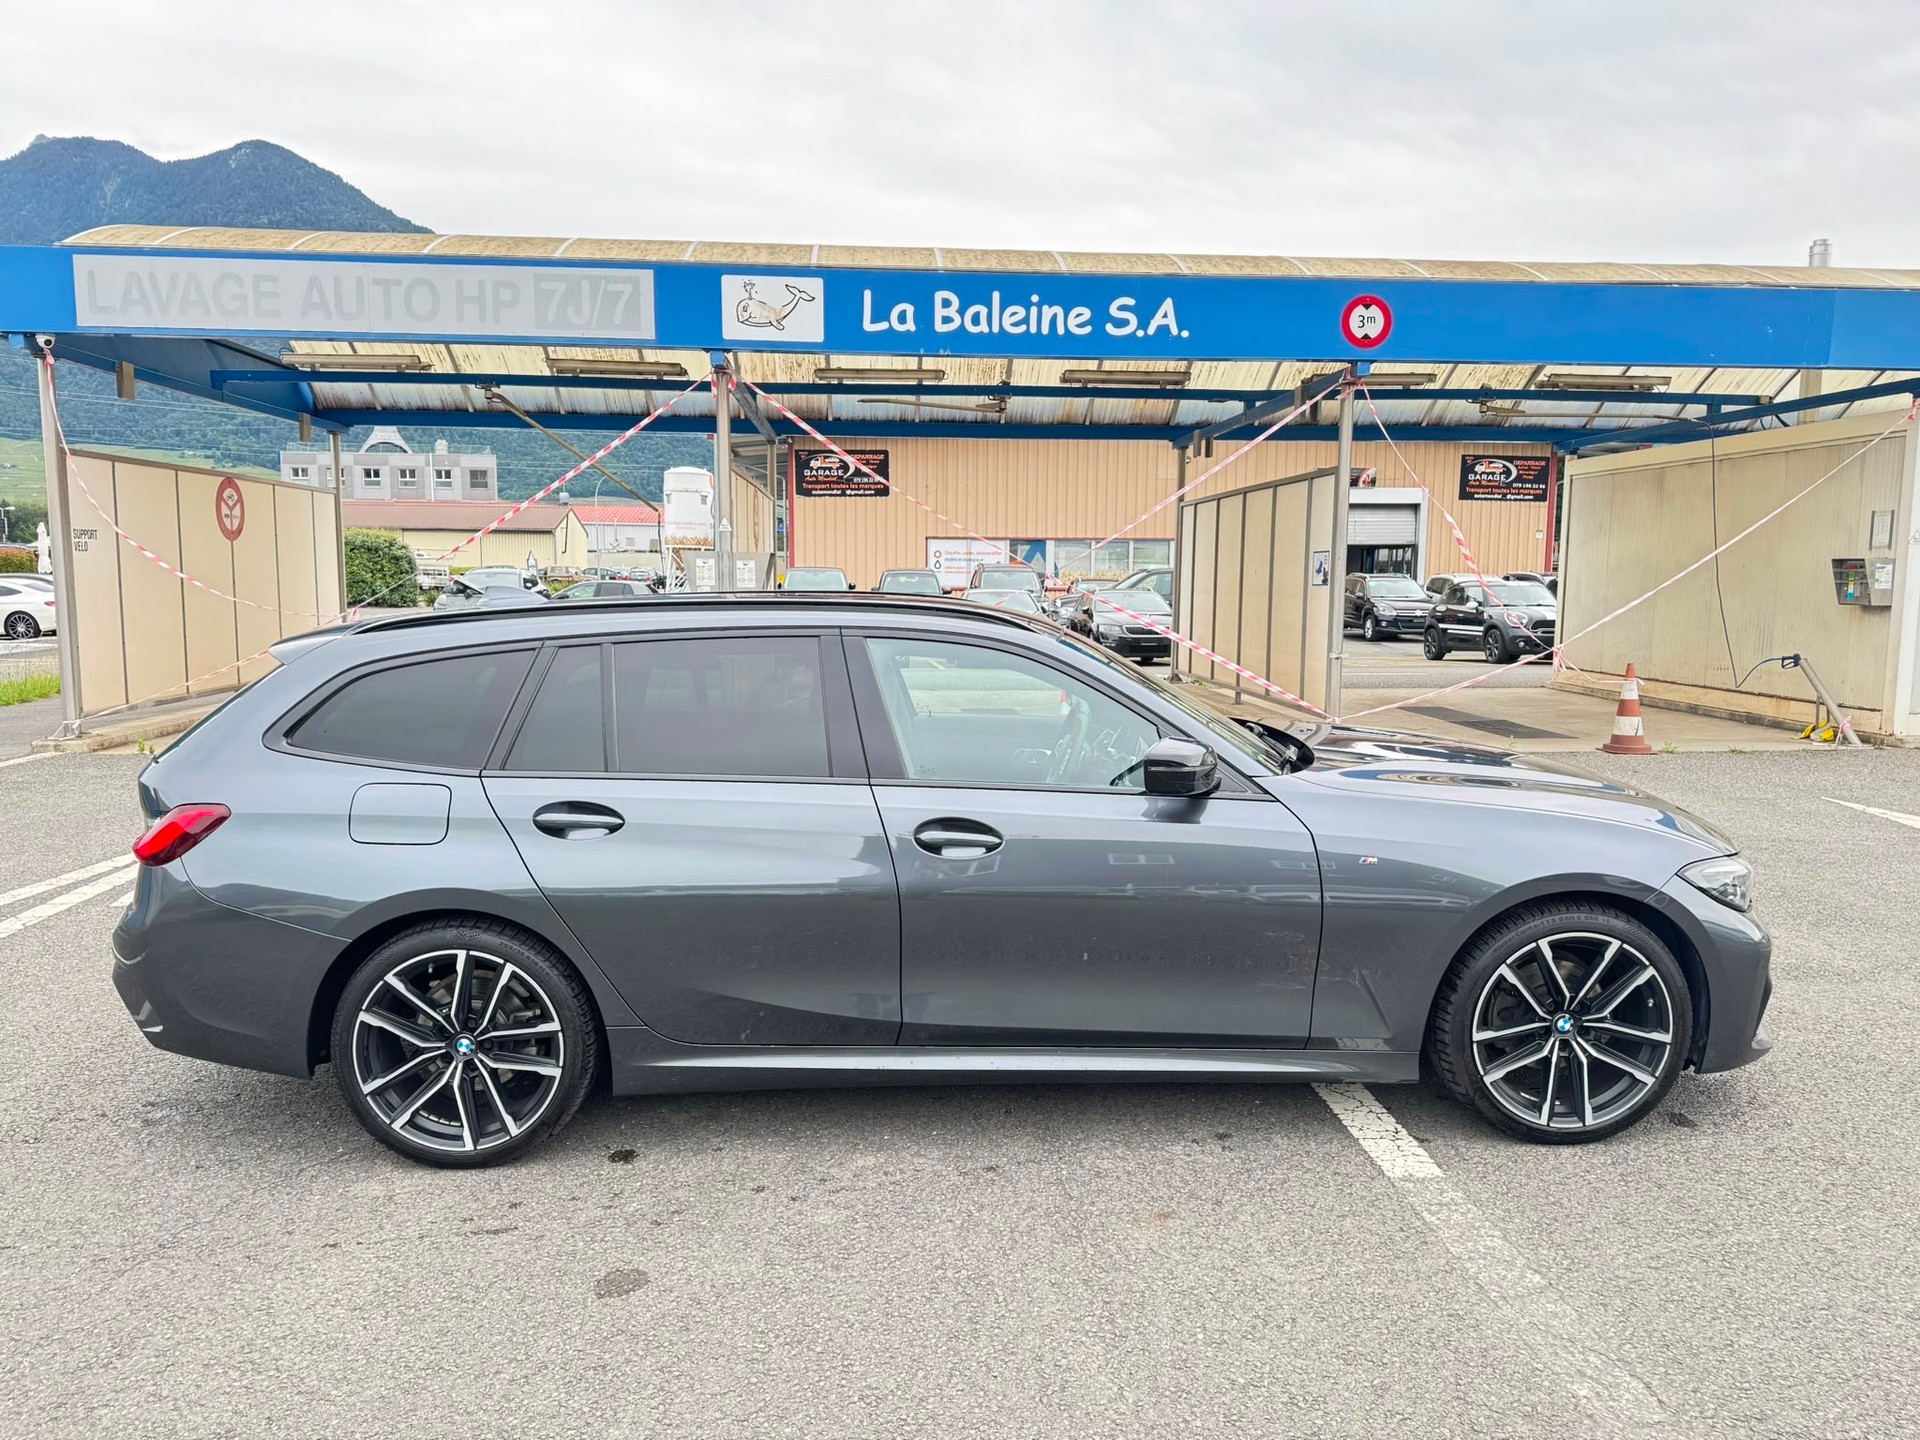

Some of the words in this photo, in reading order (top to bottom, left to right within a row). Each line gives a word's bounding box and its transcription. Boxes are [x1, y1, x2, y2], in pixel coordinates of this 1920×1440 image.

[86, 269, 282, 319] LAVAGE
[300, 274, 440, 323] AUTO
[455, 278, 521, 324] HP
[539, 279, 634, 330] 7J/7
[862, 289, 917, 332] La
[934, 290, 1093, 335] Baleine
[1105, 296, 1190, 338] S.A.
[72, 528, 98, 540] SUPPORT
